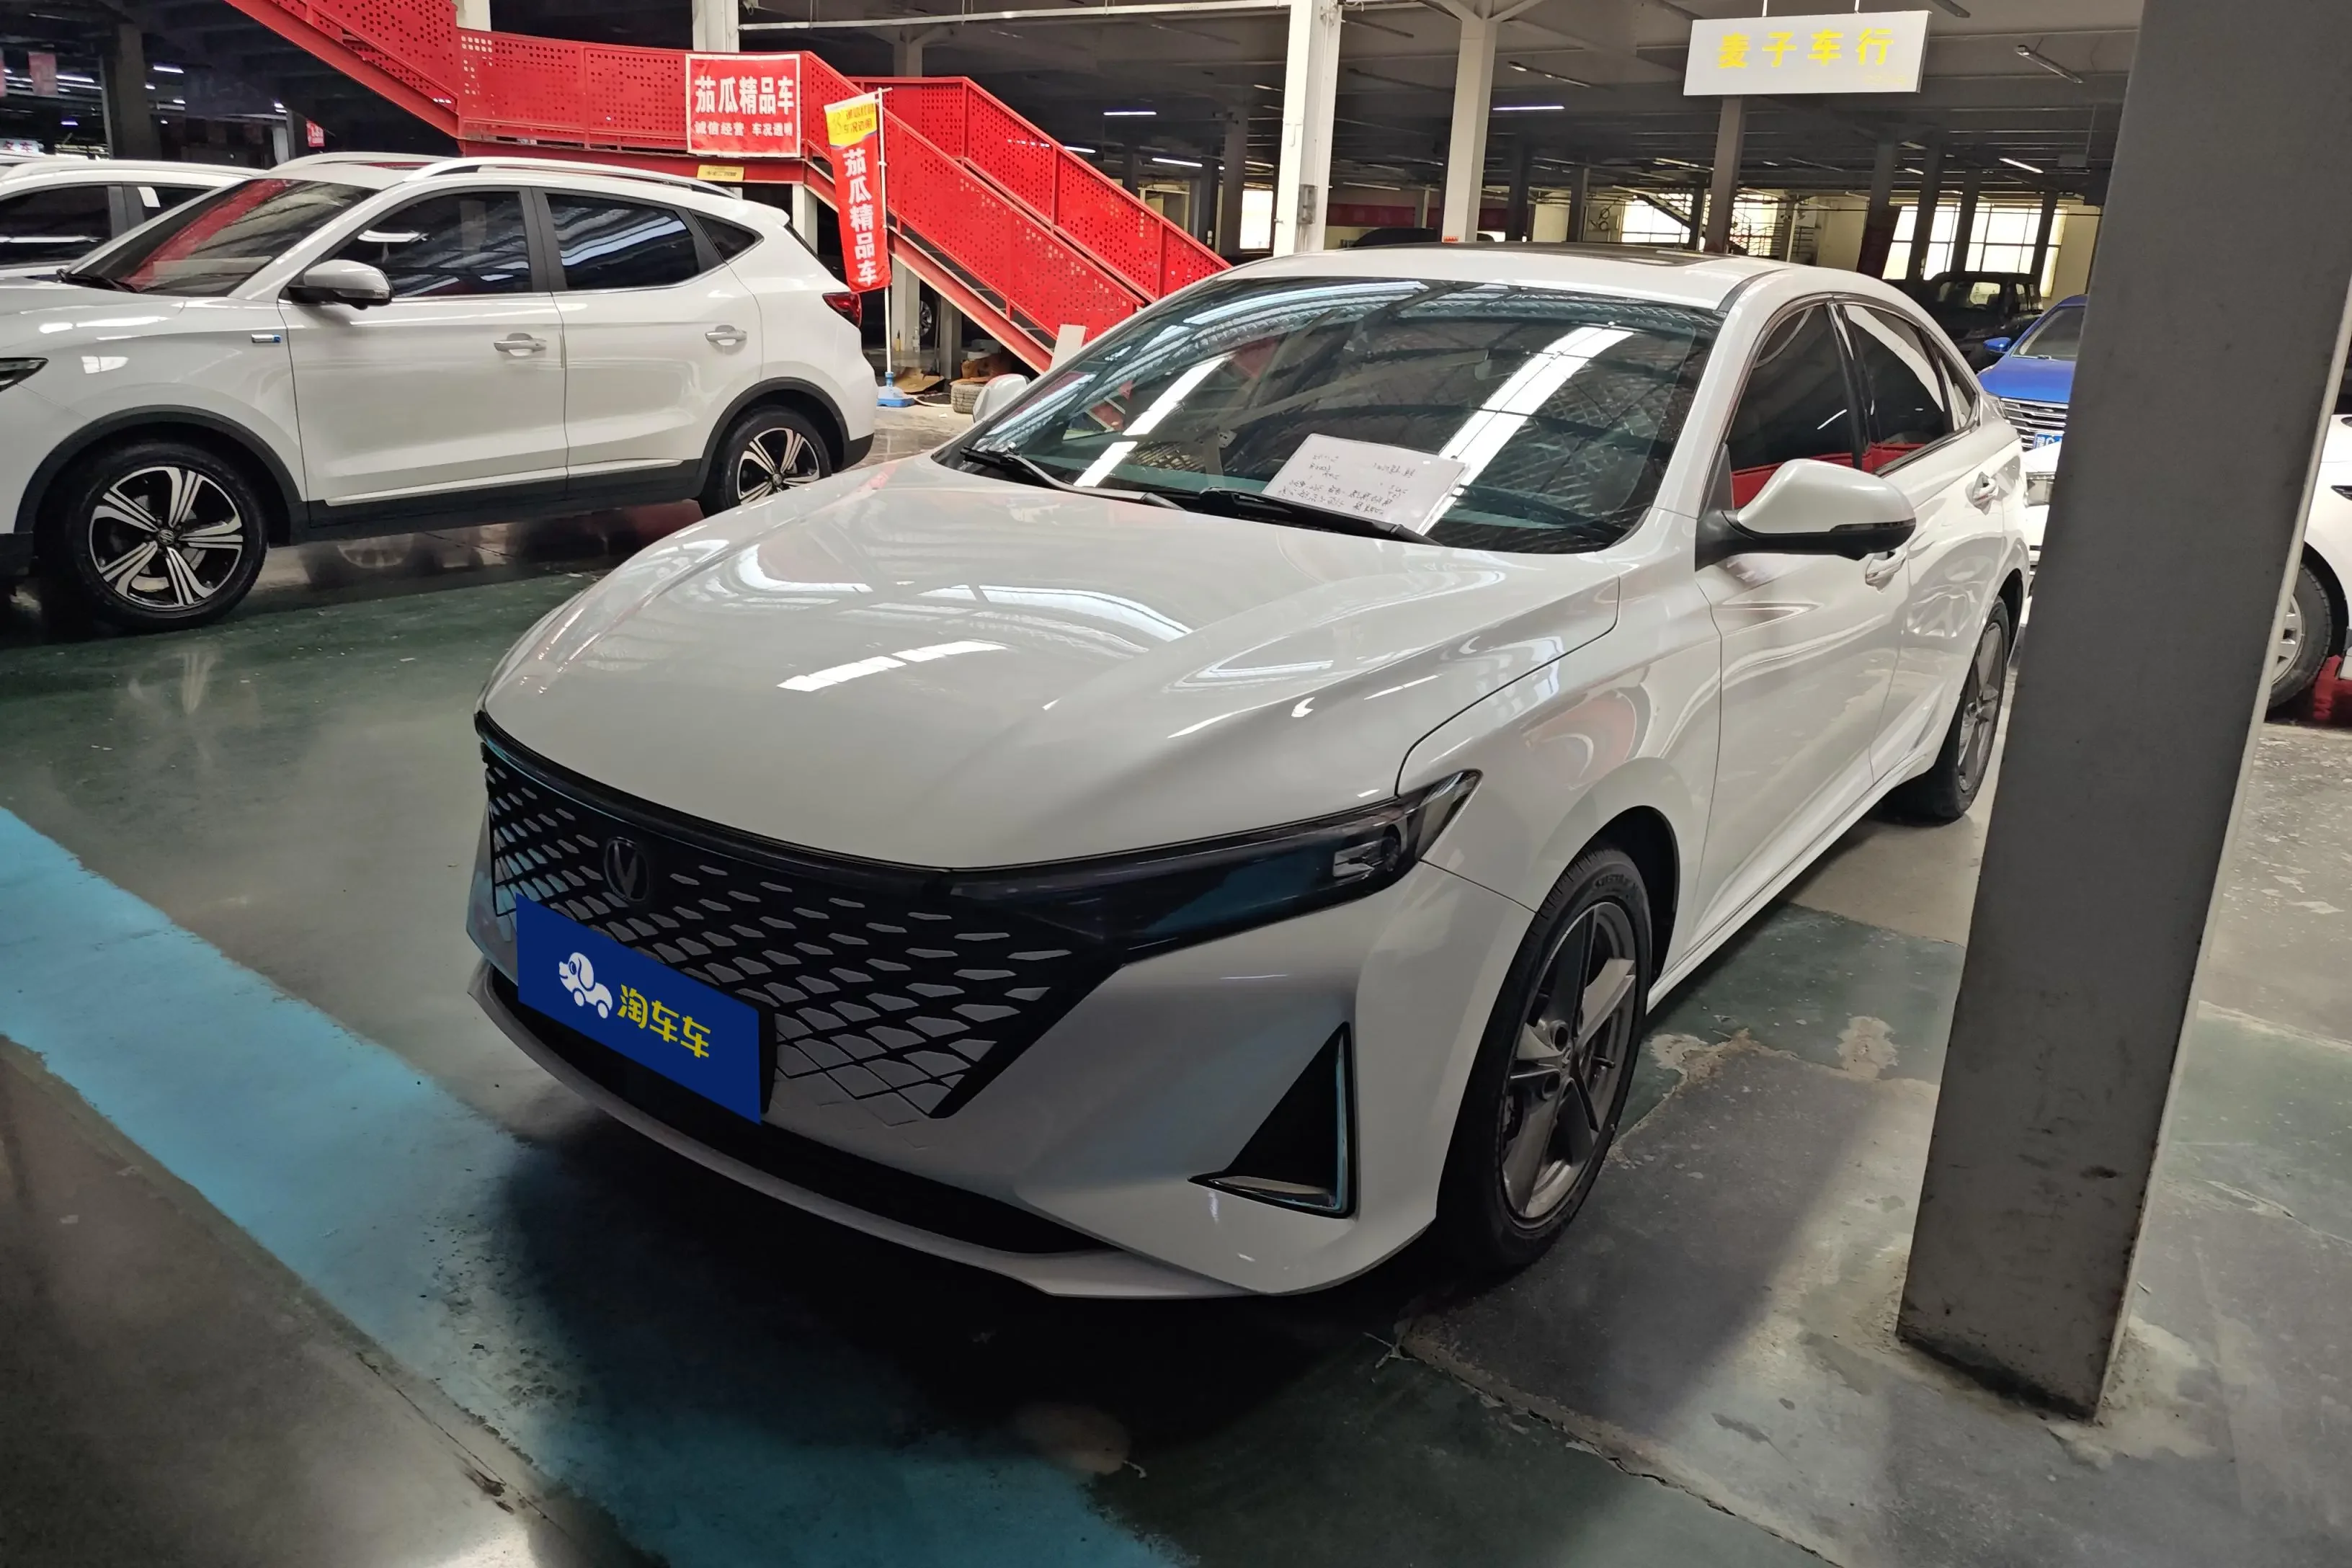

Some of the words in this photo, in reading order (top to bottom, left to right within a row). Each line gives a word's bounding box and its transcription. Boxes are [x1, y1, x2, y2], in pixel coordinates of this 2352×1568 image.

[1718, 27, 1894, 68] 麦子车行
[694, 74, 794, 115] 茄瓜精品车
[842, 147, 877, 286] 茄瓜精品车
